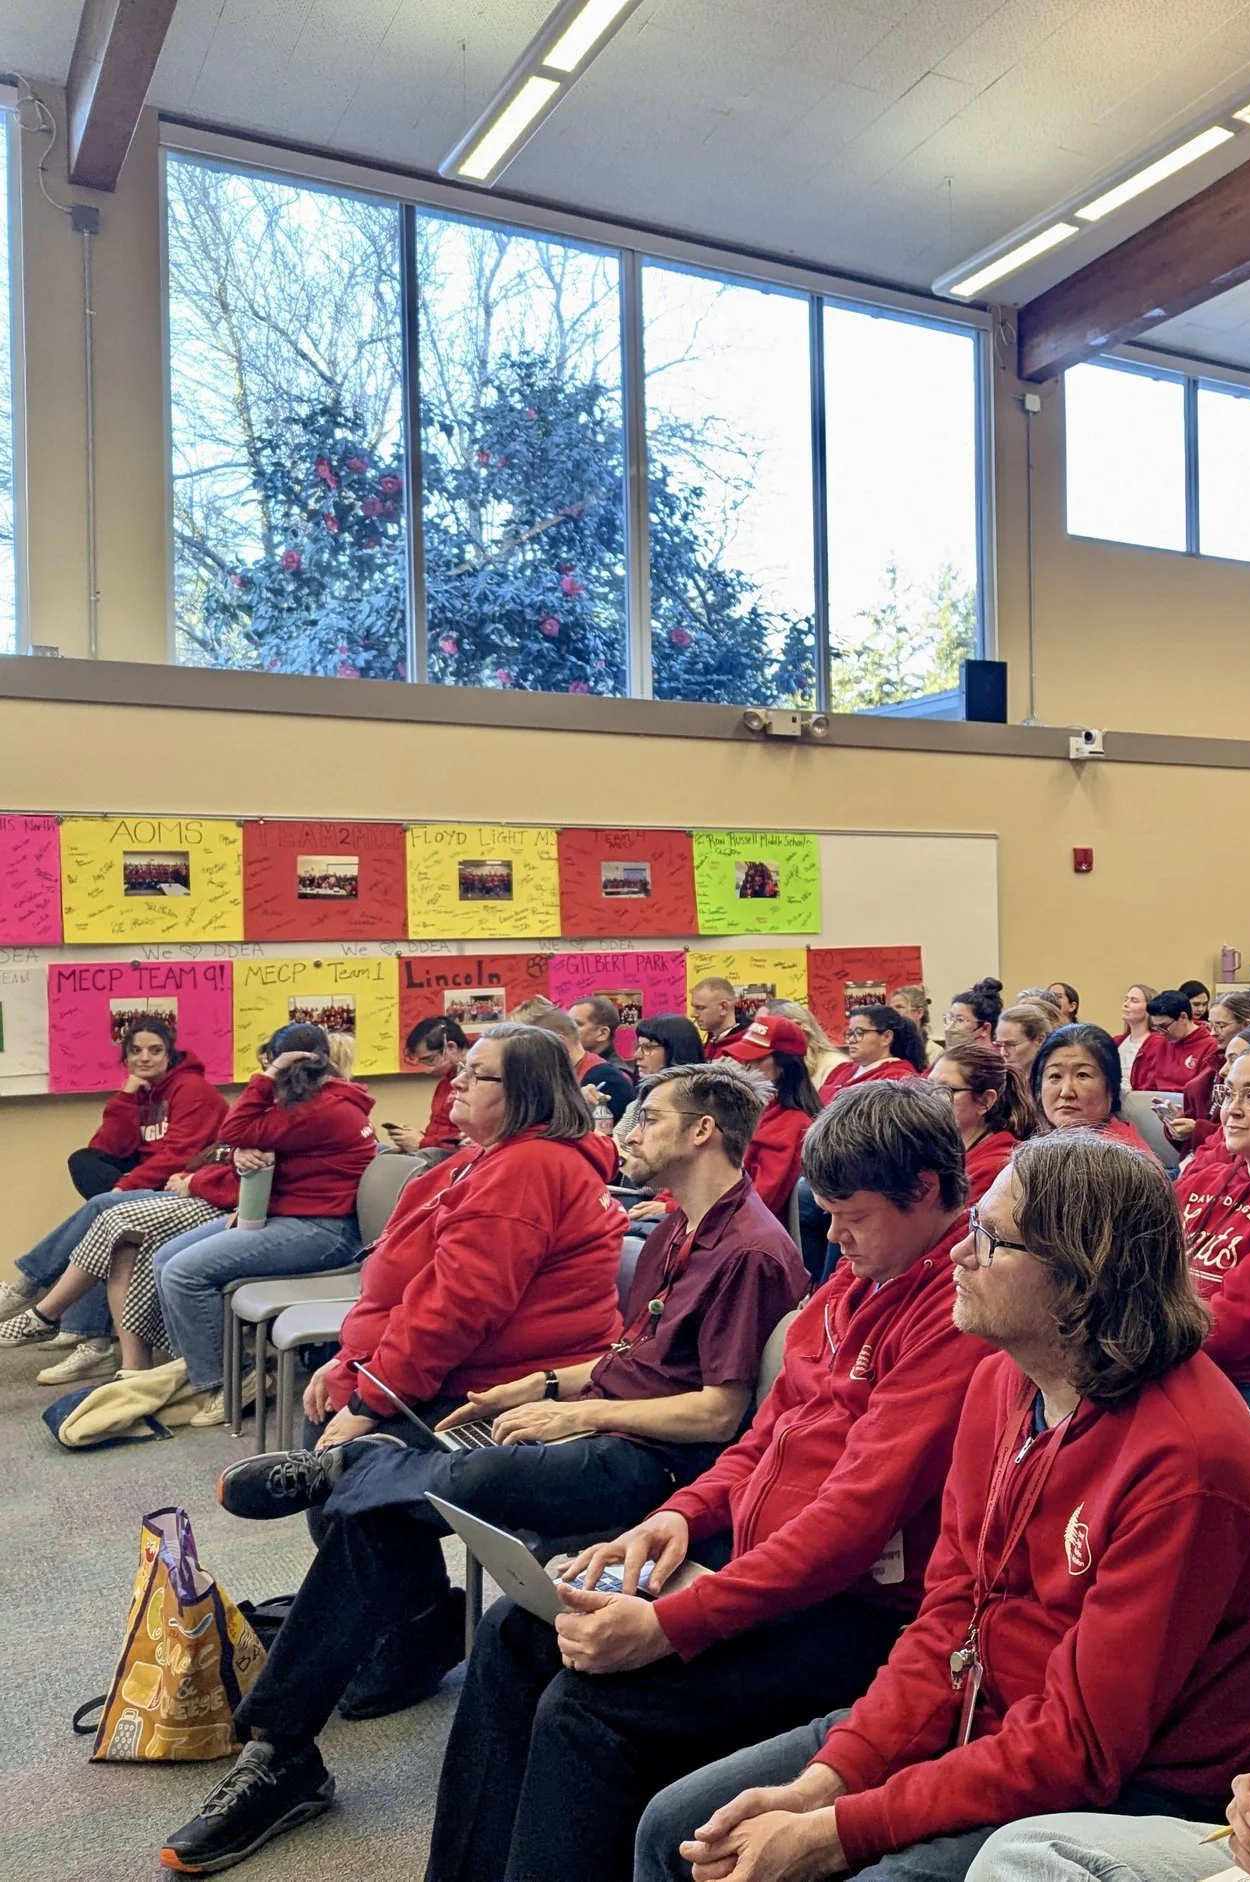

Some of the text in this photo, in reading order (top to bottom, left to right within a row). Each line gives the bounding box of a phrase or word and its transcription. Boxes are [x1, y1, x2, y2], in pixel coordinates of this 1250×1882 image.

[109, 820, 203, 845] AOMS
[339, 828, 351, 845] 2
[410, 825, 467, 848] FLOYD
[534, 830, 557, 846] MS
[727, 832, 758, 847] Russell
[784, 835, 806, 847] School
[142, 943, 264, 960] We DDEA
[340, 941, 449, 957] We DDEA
[245, 961, 384, 986] MECP Team 1
[404, 960, 500, 989] Lincoln
[566, 954, 628, 975] GILBERT
[636, 953, 669, 972] PARK
[57, 968, 122, 993] MECP
[132, 965, 198, 990] TEAM
